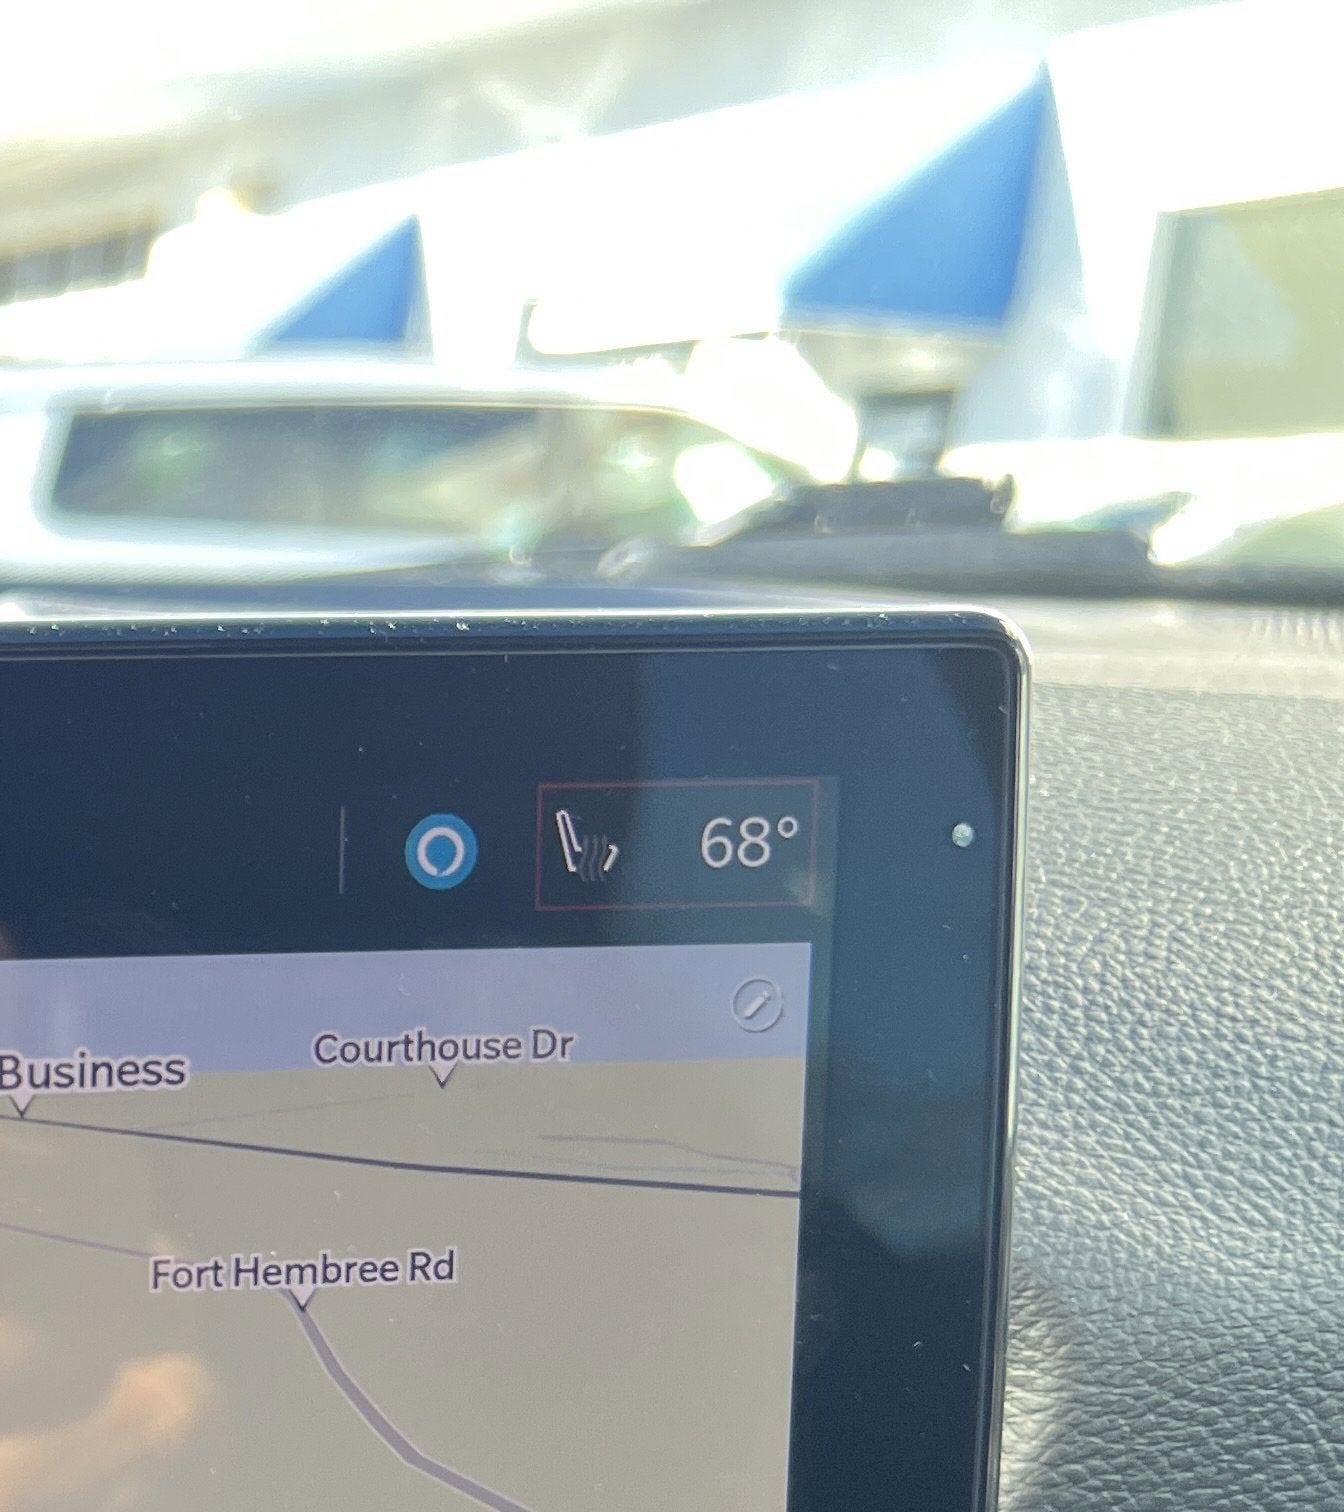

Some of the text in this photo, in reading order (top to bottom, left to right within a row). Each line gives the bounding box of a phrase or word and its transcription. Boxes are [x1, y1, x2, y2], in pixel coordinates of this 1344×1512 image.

[314, 1029, 574, 1065] Courthouse Dr
[151, 1249, 454, 1289] Fort Hembree Rd
